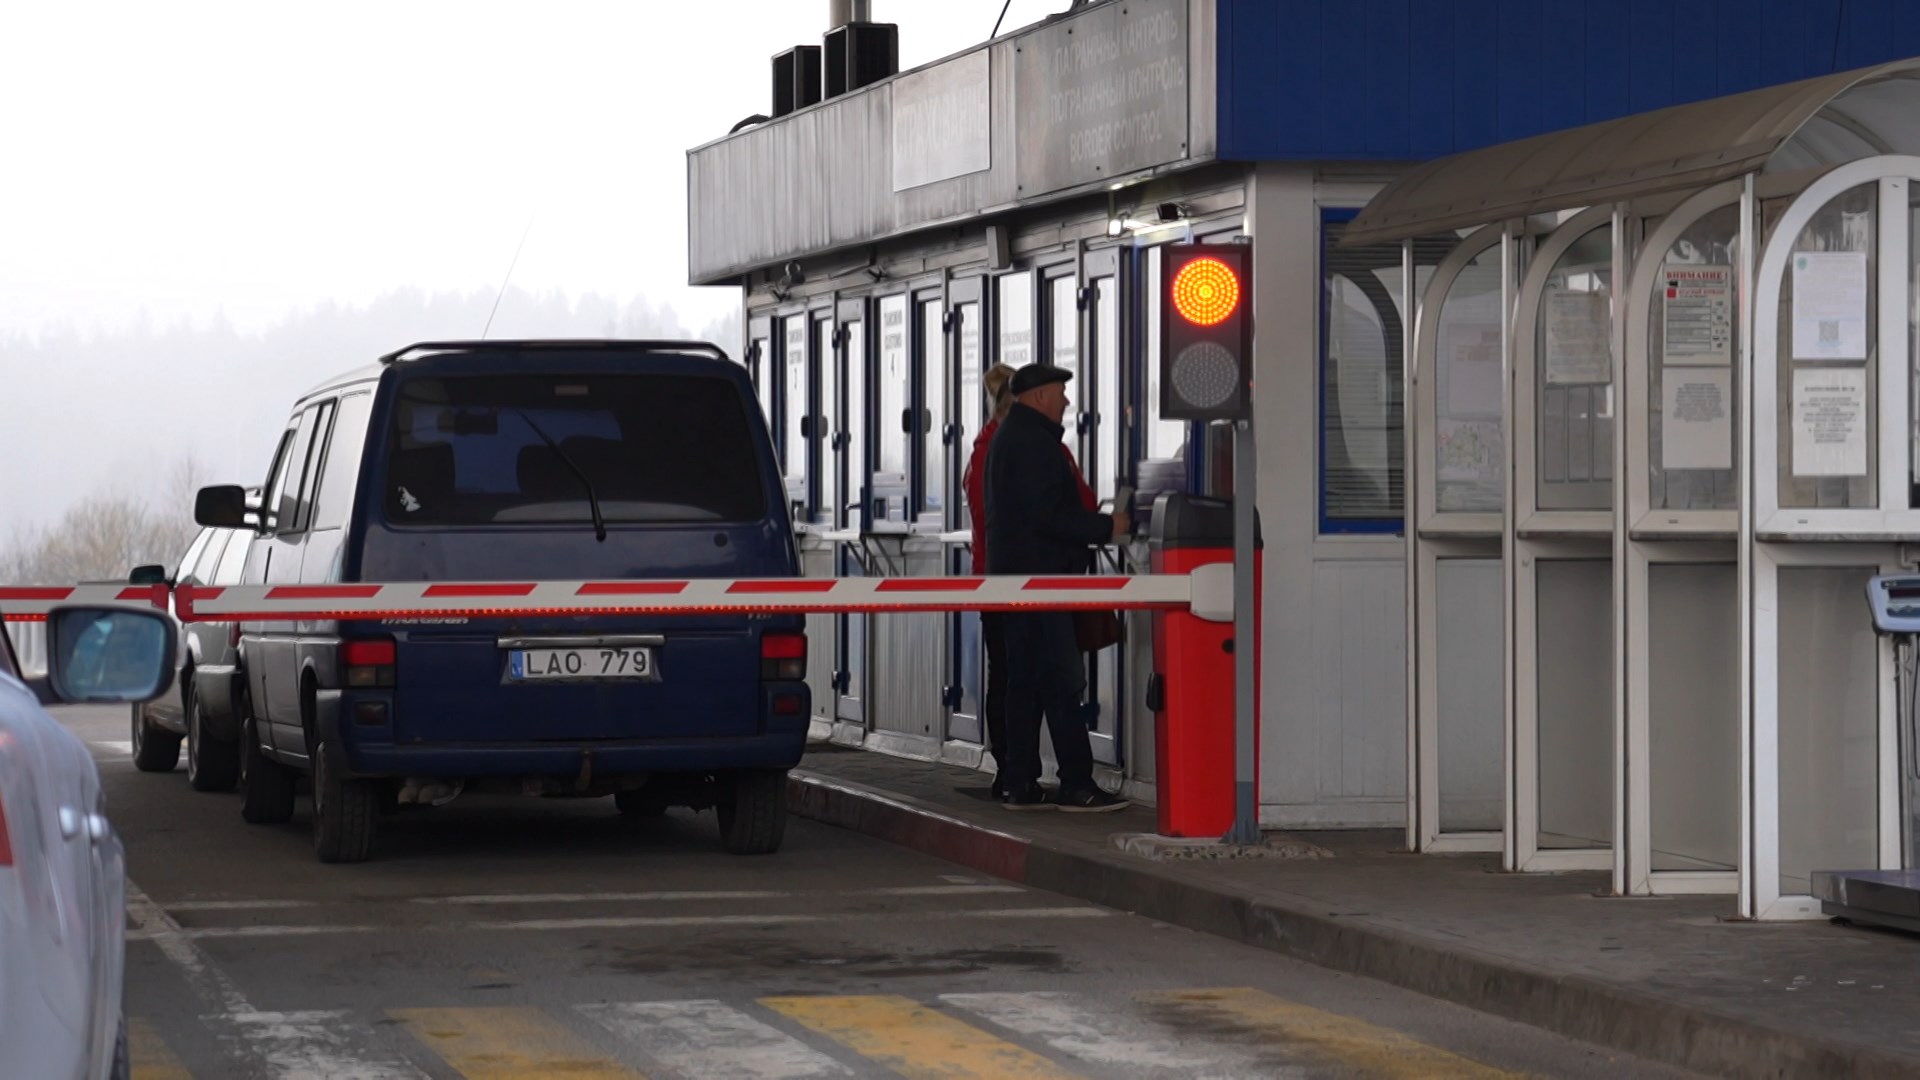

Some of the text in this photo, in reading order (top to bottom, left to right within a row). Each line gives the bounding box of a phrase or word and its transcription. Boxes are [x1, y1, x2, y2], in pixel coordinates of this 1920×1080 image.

[1122, 10, 1178, 56] КАНТРОЛЬ
[1050, 56, 1185, 126] ПОГРАНИЧНЫЙ КОНТРОЛЬ
[1070, 108, 1163, 163] BORDER CONTROL
[526, 651, 648, 675] LAO 779
